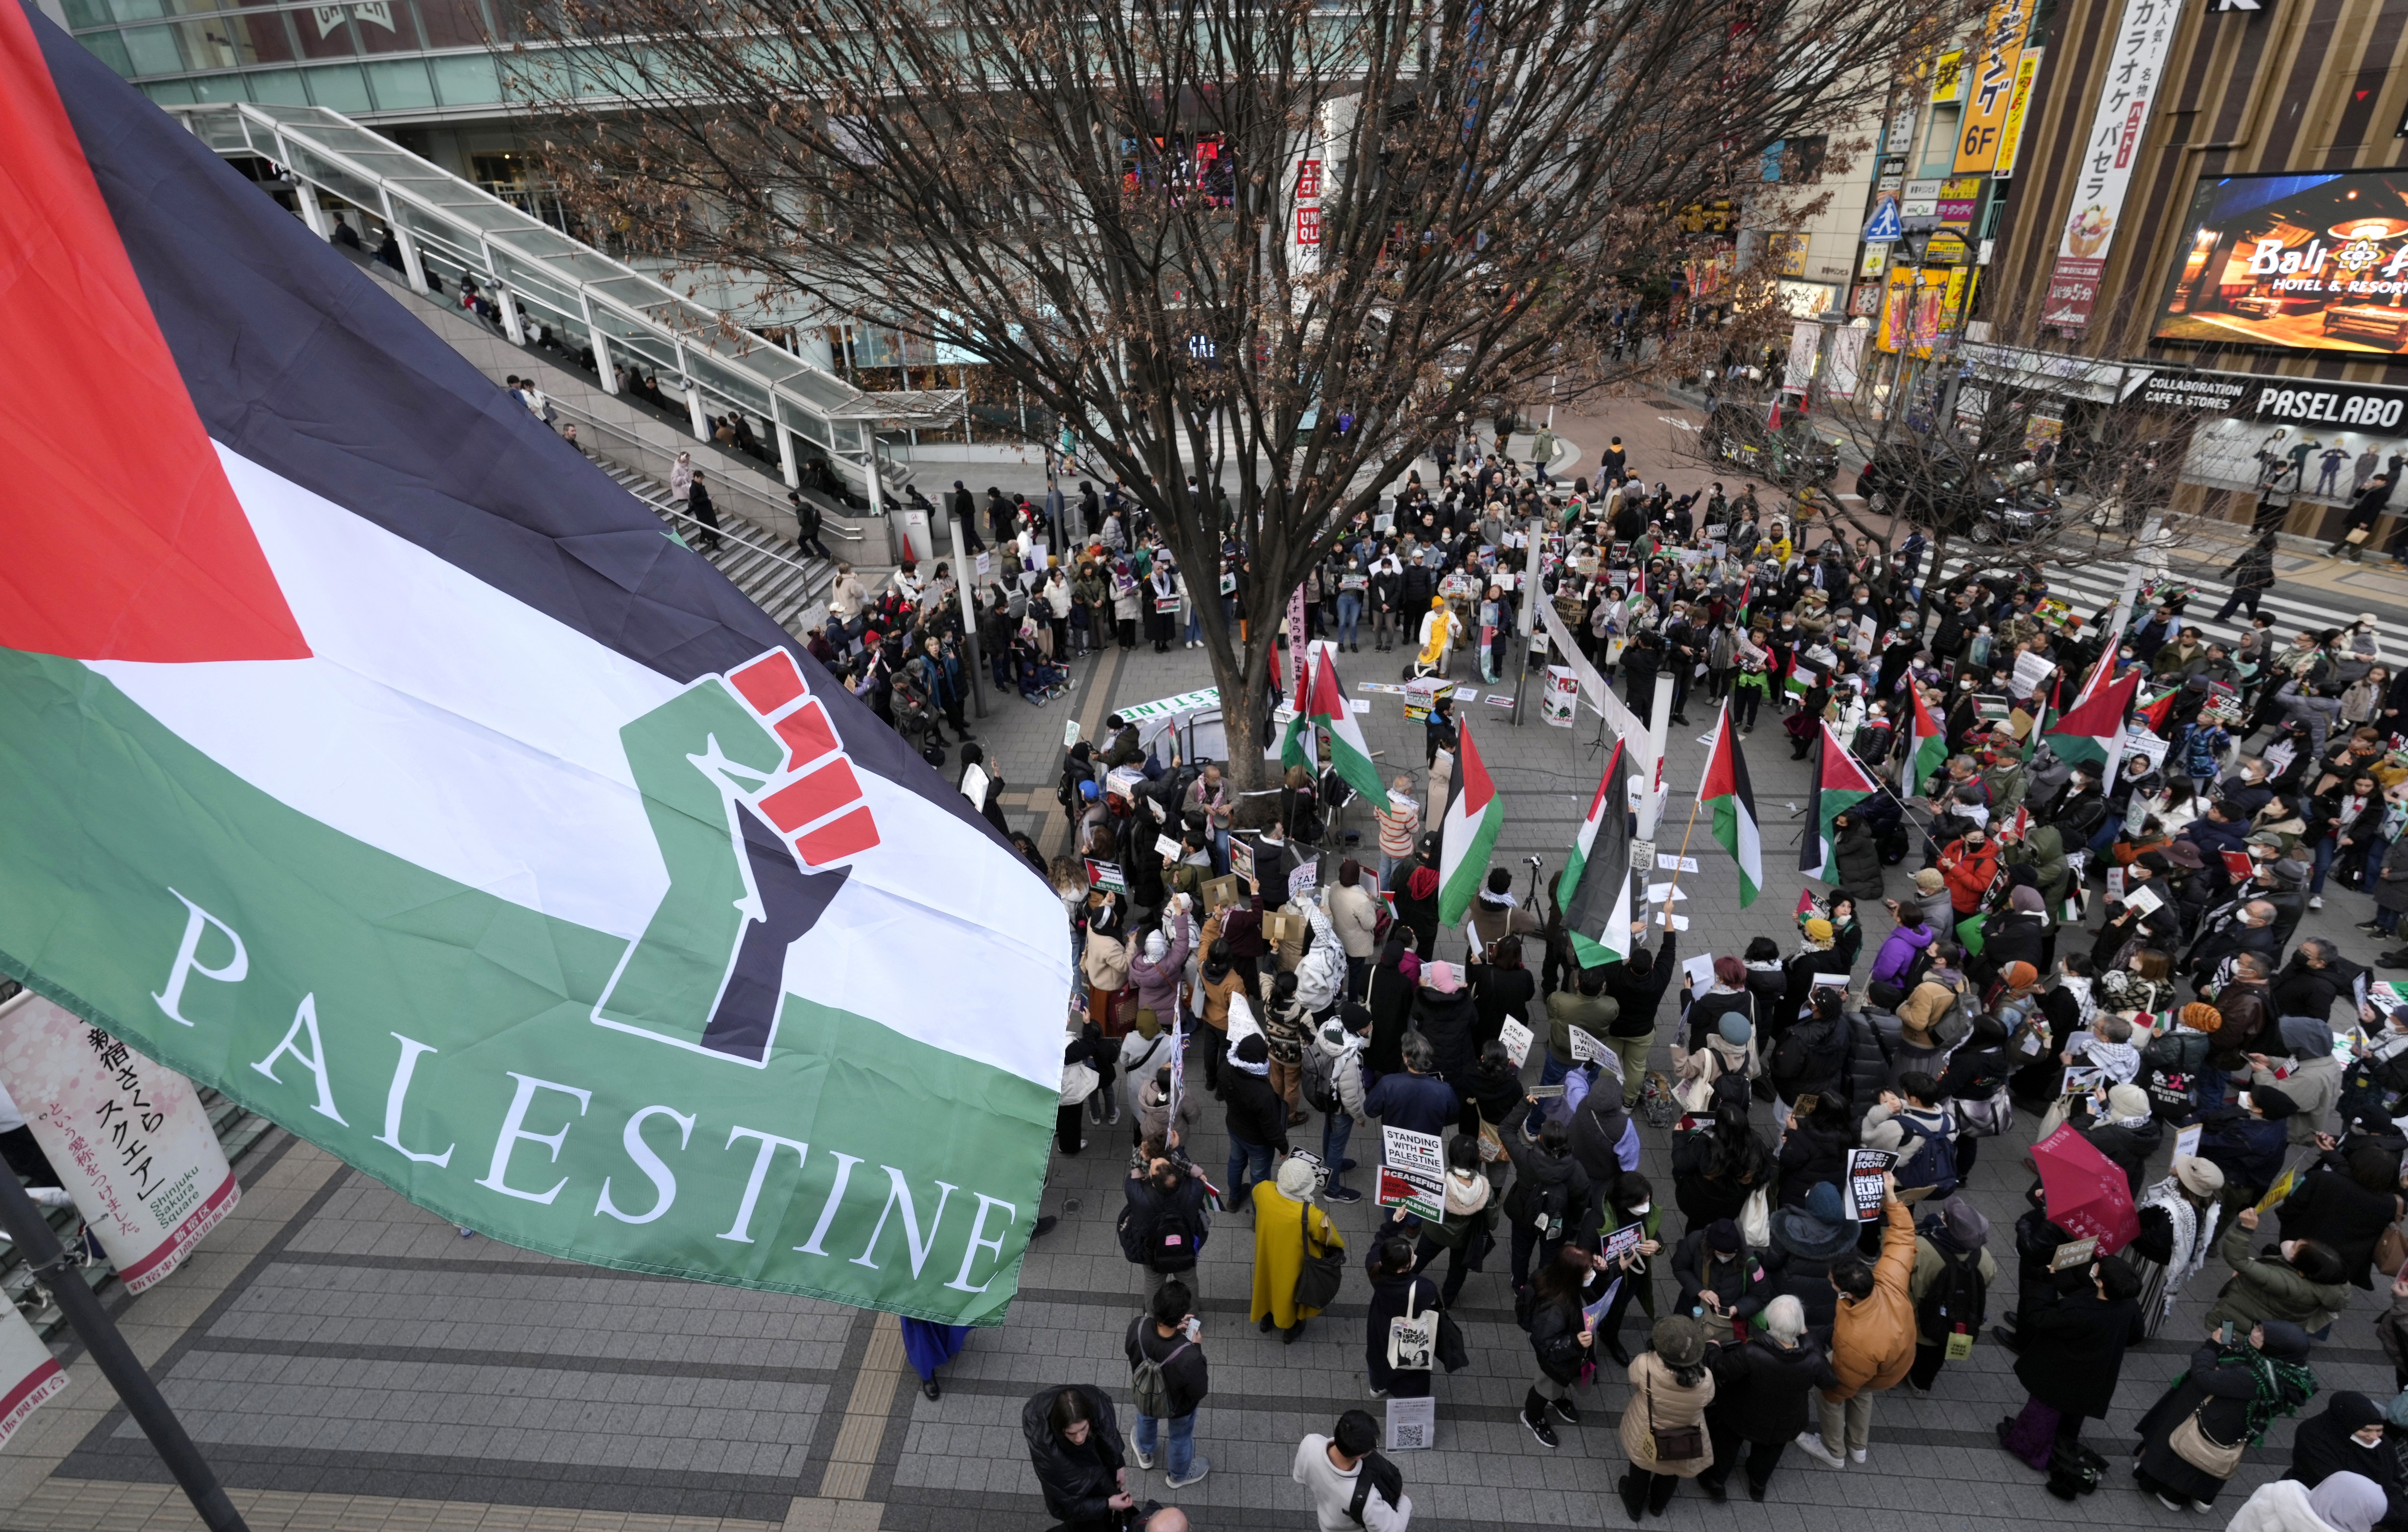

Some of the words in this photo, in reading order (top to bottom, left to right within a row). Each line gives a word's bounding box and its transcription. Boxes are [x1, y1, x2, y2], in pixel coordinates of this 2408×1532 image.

[2110, 1, 2155, 112] カラオケ
[2136, 68, 2152, 98] 名物
[1964, 125, 1996, 156] 6F
[2087, 121, 2123, 200] パセラ
[2246, 239, 2327, 274] Bali
[2273, 278, 2323, 291] HOTEL
[2328, 279, 2342, 292] &
[2149, 377, 2243, 397] COLLABORATION
[2145, 391, 2174, 404] CAFE
[2174, 394, 2183, 405] &
[2186, 395, 2231, 410] STORES
[2256, 388, 2404, 427] PASELABO
[1406, 685, 1421, 694] Stop
[1412, 695, 1432, 705] GAZA
[1095, 866, 1120, 874] GENOCIDE
[1289, 874, 1314, 893] GAZA!
[150, 885, 1018, 1295] PALESTINE
[1387, 1130, 1439, 1149] STANDING
[1393, 1141, 1417, 1153] WITH
[2179, 1139, 2194, 1148] FREE
[1389, 1149, 1441, 1167] PALESTINE
[1855, 1161, 1887, 1169] ITOCHU
[49, 1102, 140, 1236] という愛称をつけました。
[1414, 1162, 1441, 1174] OCCUPATION
[1384, 1169, 1442, 1193] #CEASEFIRE
[1853, 1174, 1883, 1183] ISRAEL'S
[150, 1166, 199, 1212] Shinjuku
[1398, 1189, 1438, 1208] OCCUPATION
[1402, 1183, 1433, 1199] GENOCIDE
[1855, 1183, 1884, 1196] ELBIT
[155, 1182, 195, 1221] Sakura
[160, 1191, 200, 1230] Square
[1382, 1195, 1400, 1203] FREE
[1401, 1197, 1438, 1217] PALESTINE
[173, 1207, 211, 1245] 新宿区
[130, 1186, 241, 1292] 新宿東口商店街振興組
[1609, 1227, 1636, 1245] RAVERS
